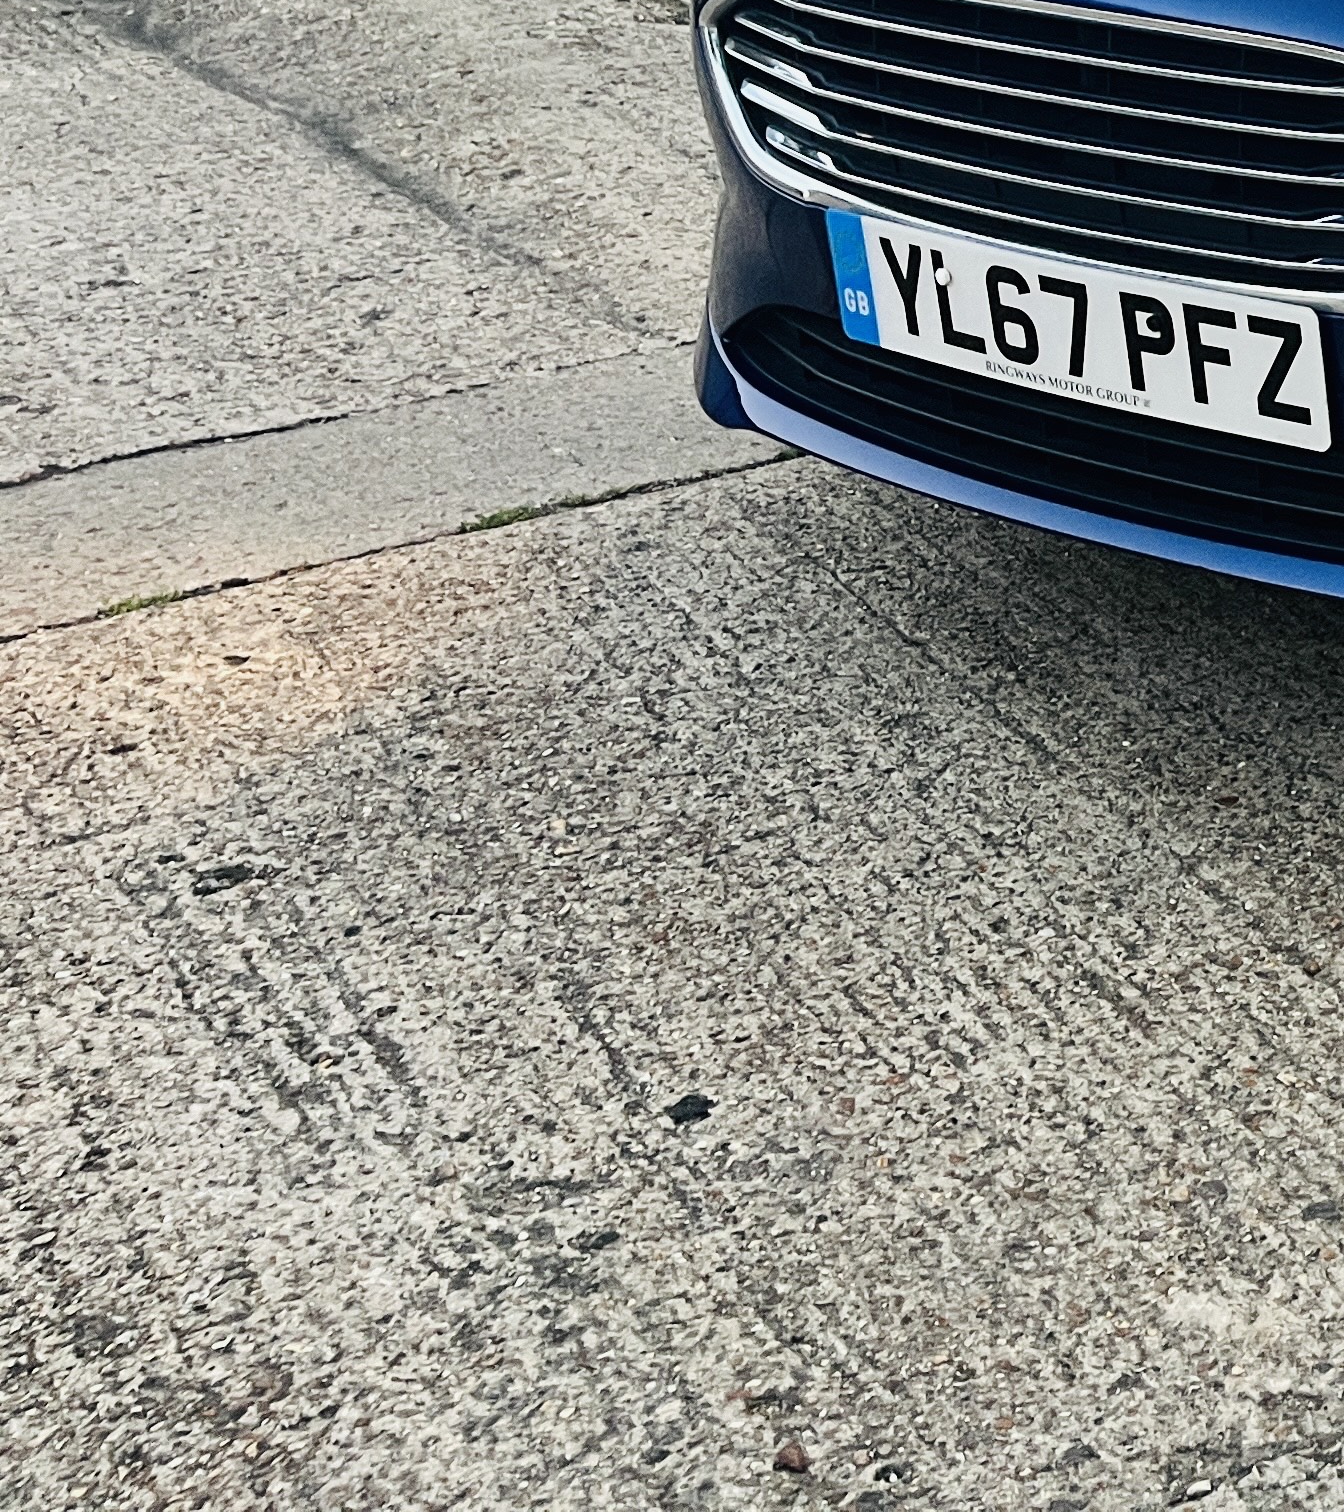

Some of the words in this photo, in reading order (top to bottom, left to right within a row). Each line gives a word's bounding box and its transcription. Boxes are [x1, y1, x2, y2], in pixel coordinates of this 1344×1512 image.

[843, 287, 870, 316] GB
[878, 236, 1088, 378] YL67
[1119, 291, 1312, 426] PFZ
[985, 360, 1046, 385] RINGWAYS
[1048, 376, 1093, 397] MOTOR
[1096, 387, 1140, 407] GROUP
